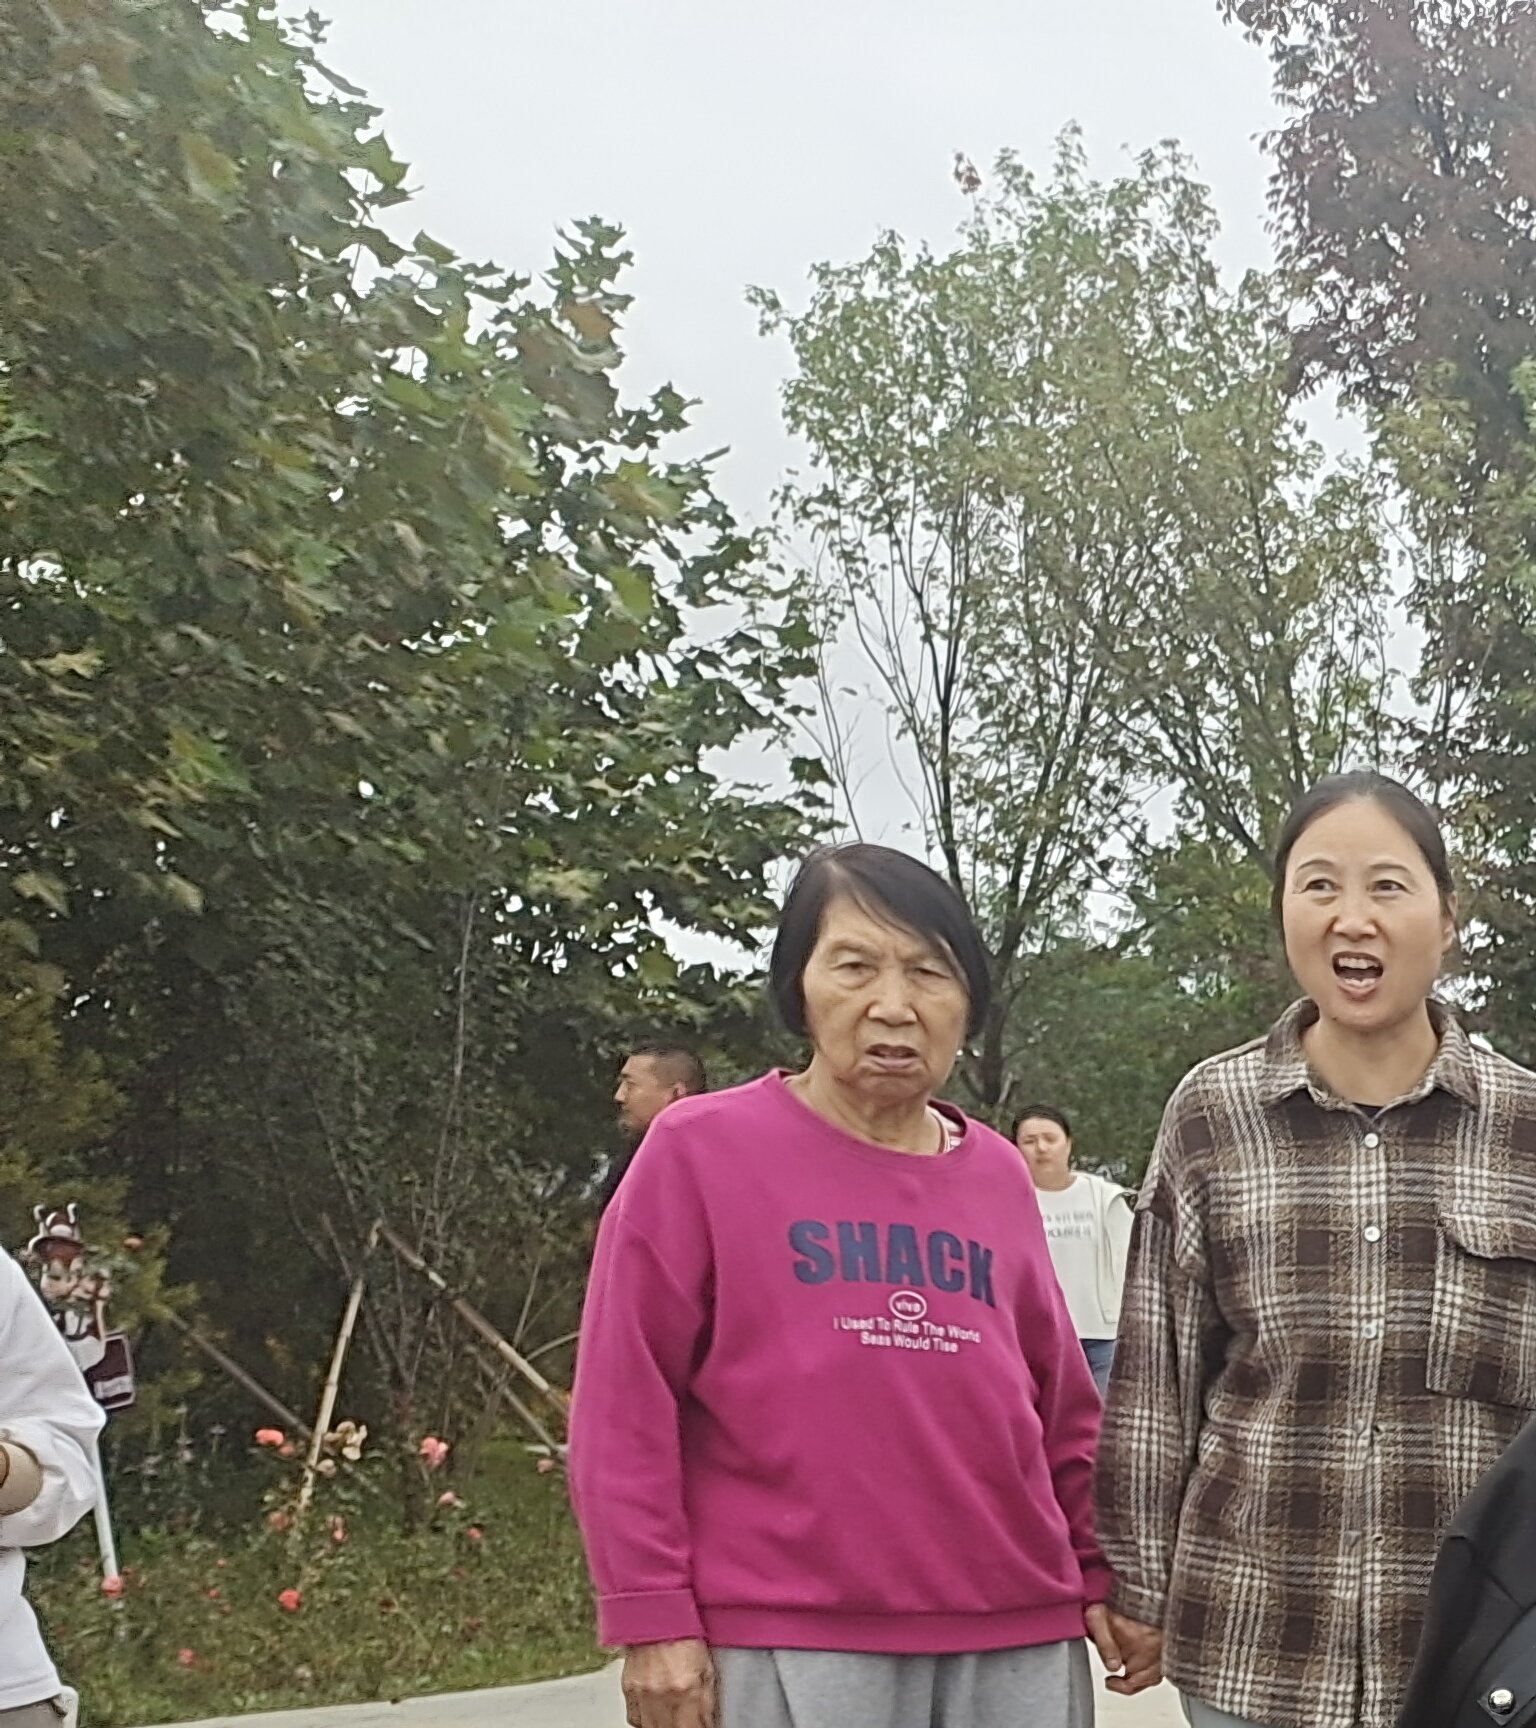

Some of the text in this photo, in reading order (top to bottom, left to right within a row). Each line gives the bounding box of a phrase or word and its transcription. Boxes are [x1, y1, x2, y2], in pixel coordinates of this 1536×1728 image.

[788, 1219, 996, 1308] SHACK
[841, 1317, 875, 1329] Used
[877, 1317, 890, 1331] To
[893, 1319, 919, 1334] Rule
[921, 1321, 945, 1337] The
[947, 1324, 981, 1343] World
[893, 1333, 930, 1350] Would
